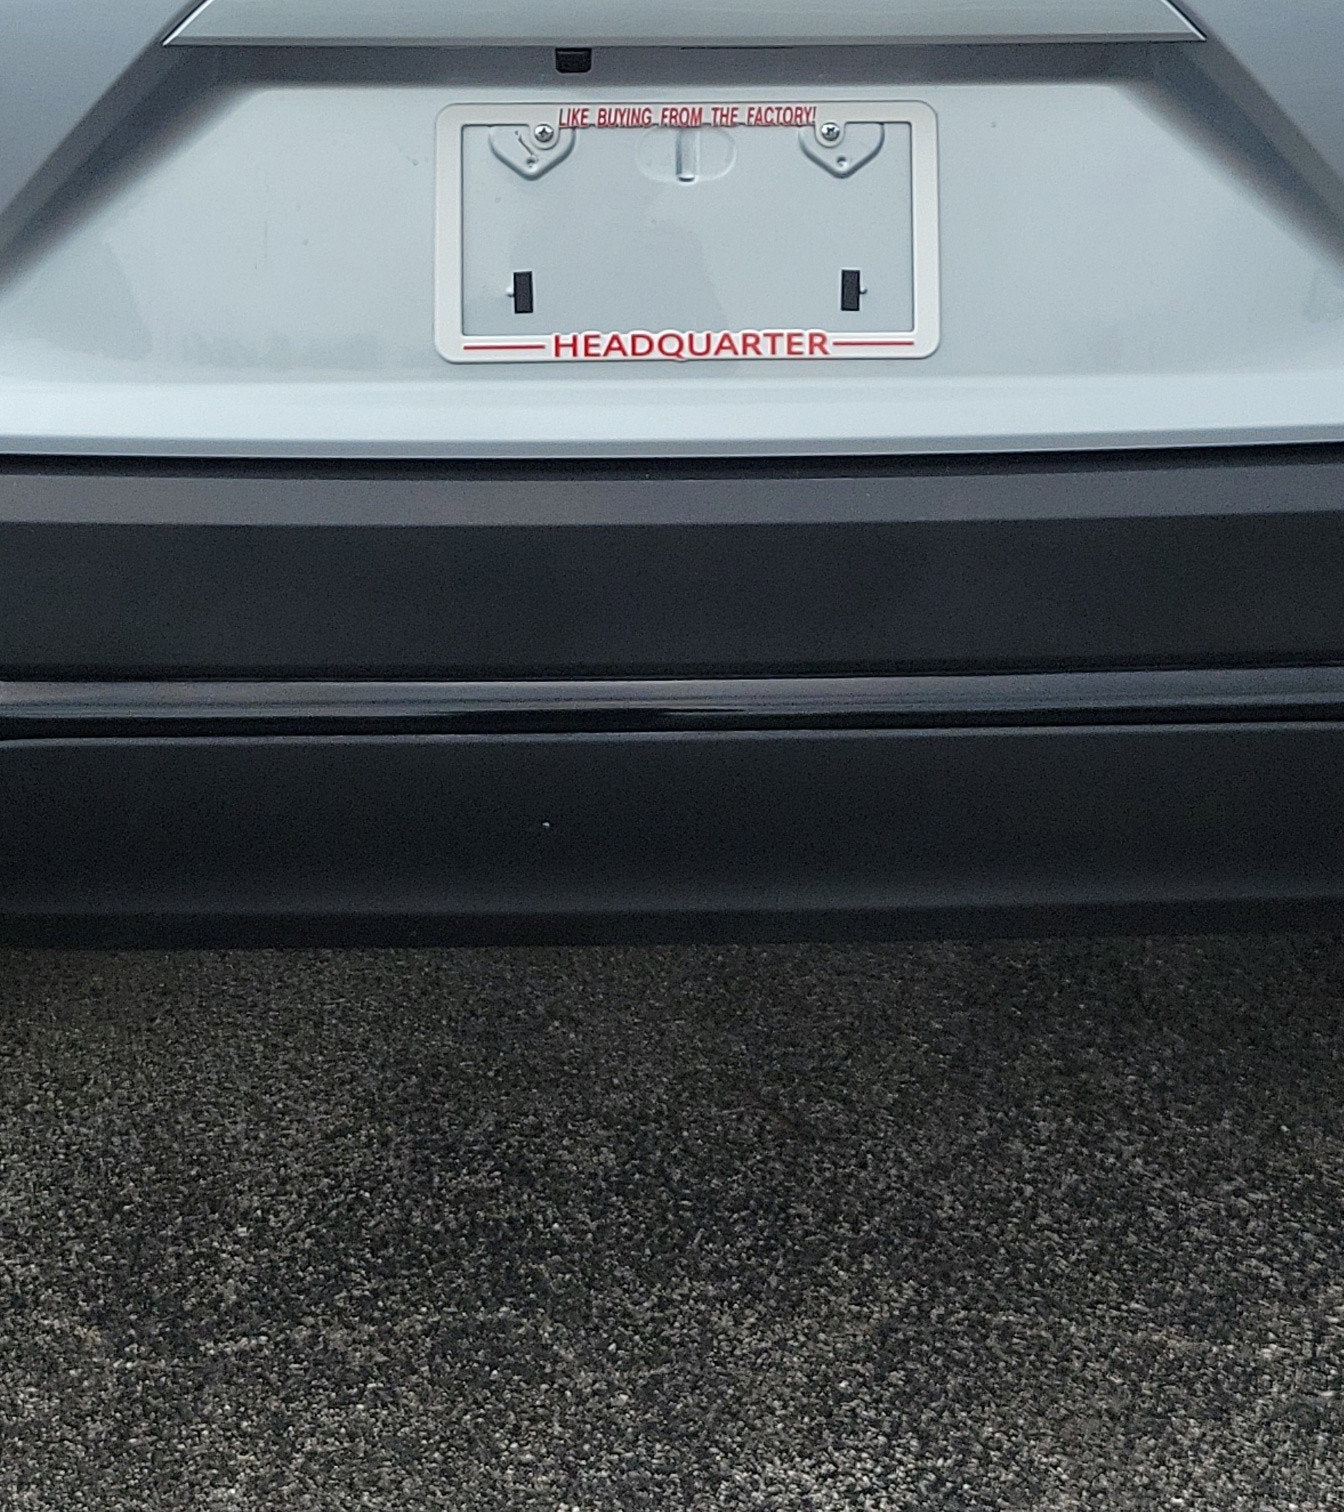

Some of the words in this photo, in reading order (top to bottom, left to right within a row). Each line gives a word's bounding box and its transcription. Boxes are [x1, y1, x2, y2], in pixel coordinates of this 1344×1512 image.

[558, 108, 589, 126] LIKE
[597, 108, 652, 126] BUYING
[661, 107, 702, 126] FROM
[712, 107, 738, 125] THE
[747, 107, 817, 125] FACTORY!
[553, 331, 829, 359] HEADQUARTER
